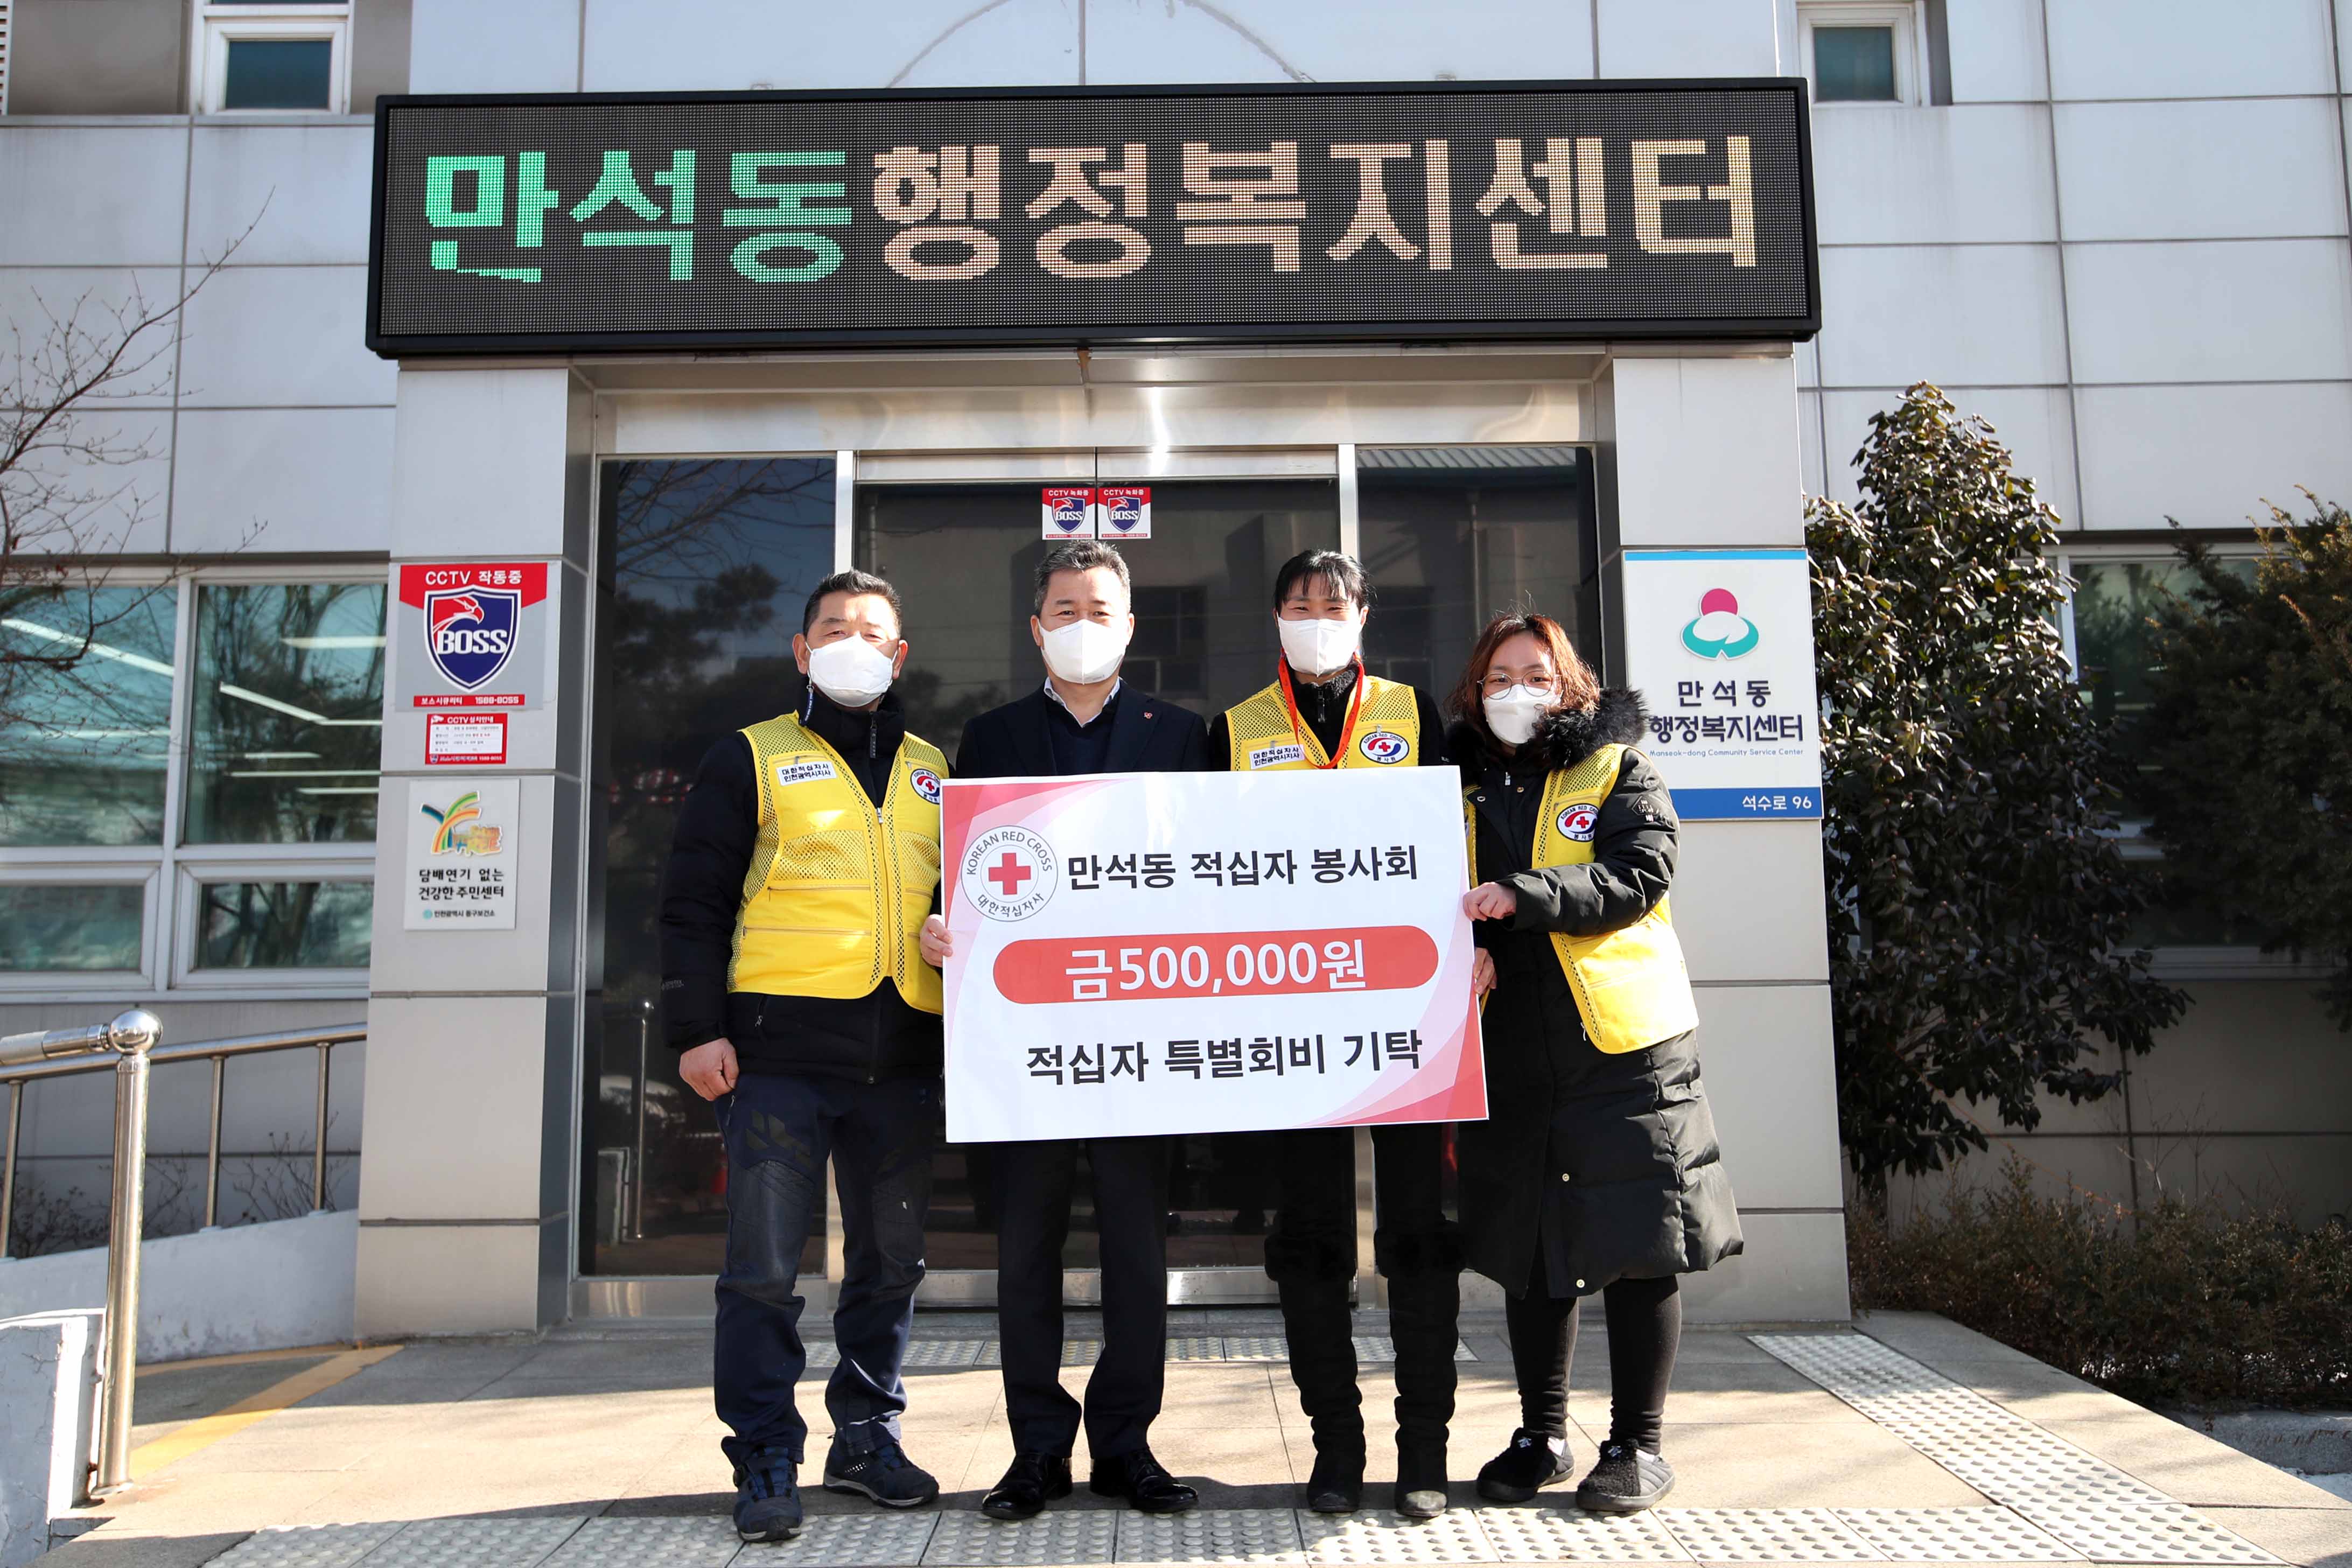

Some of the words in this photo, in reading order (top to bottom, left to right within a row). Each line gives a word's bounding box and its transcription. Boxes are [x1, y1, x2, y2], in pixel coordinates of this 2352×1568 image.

[1055, 511, 1083, 521] BOSS
[1110, 510, 1138, 520] BOSS
[425, 571, 471, 585] CCTV
[478, 570, 522, 585] 작동중
[437, 629, 508, 655] BOSS
[1649, 715, 1803, 744] 행정복지센터
[782, 764, 829, 775] 대한적십자사
[1742, 795, 1787, 810] 석수로
[1792, 796, 1812, 809] 96
[967, 834, 999, 875] KOREAN
[1002, 831, 1025, 842] RED
[1027, 838, 1053, 871] CROSS
[419, 869, 470, 883] 담배연기
[479, 868, 504, 882] 없는
[1068, 853, 1176, 890] 만석동
[1191, 849, 1297, 887] 적십자
[1311, 845, 1417, 883] 봉사회
[418, 886, 454, 901] 건강한
[456, 886, 504, 900] 주민센터
[978, 892, 1044, 917] 대한적십자사
[1066, 939, 1366, 1000] 금500,000원
[1027, 1041, 1149, 1084] 적십자
[1164, 1034, 1325, 1080] 특별회비
[1343, 1029, 1423, 1071] 기탁
